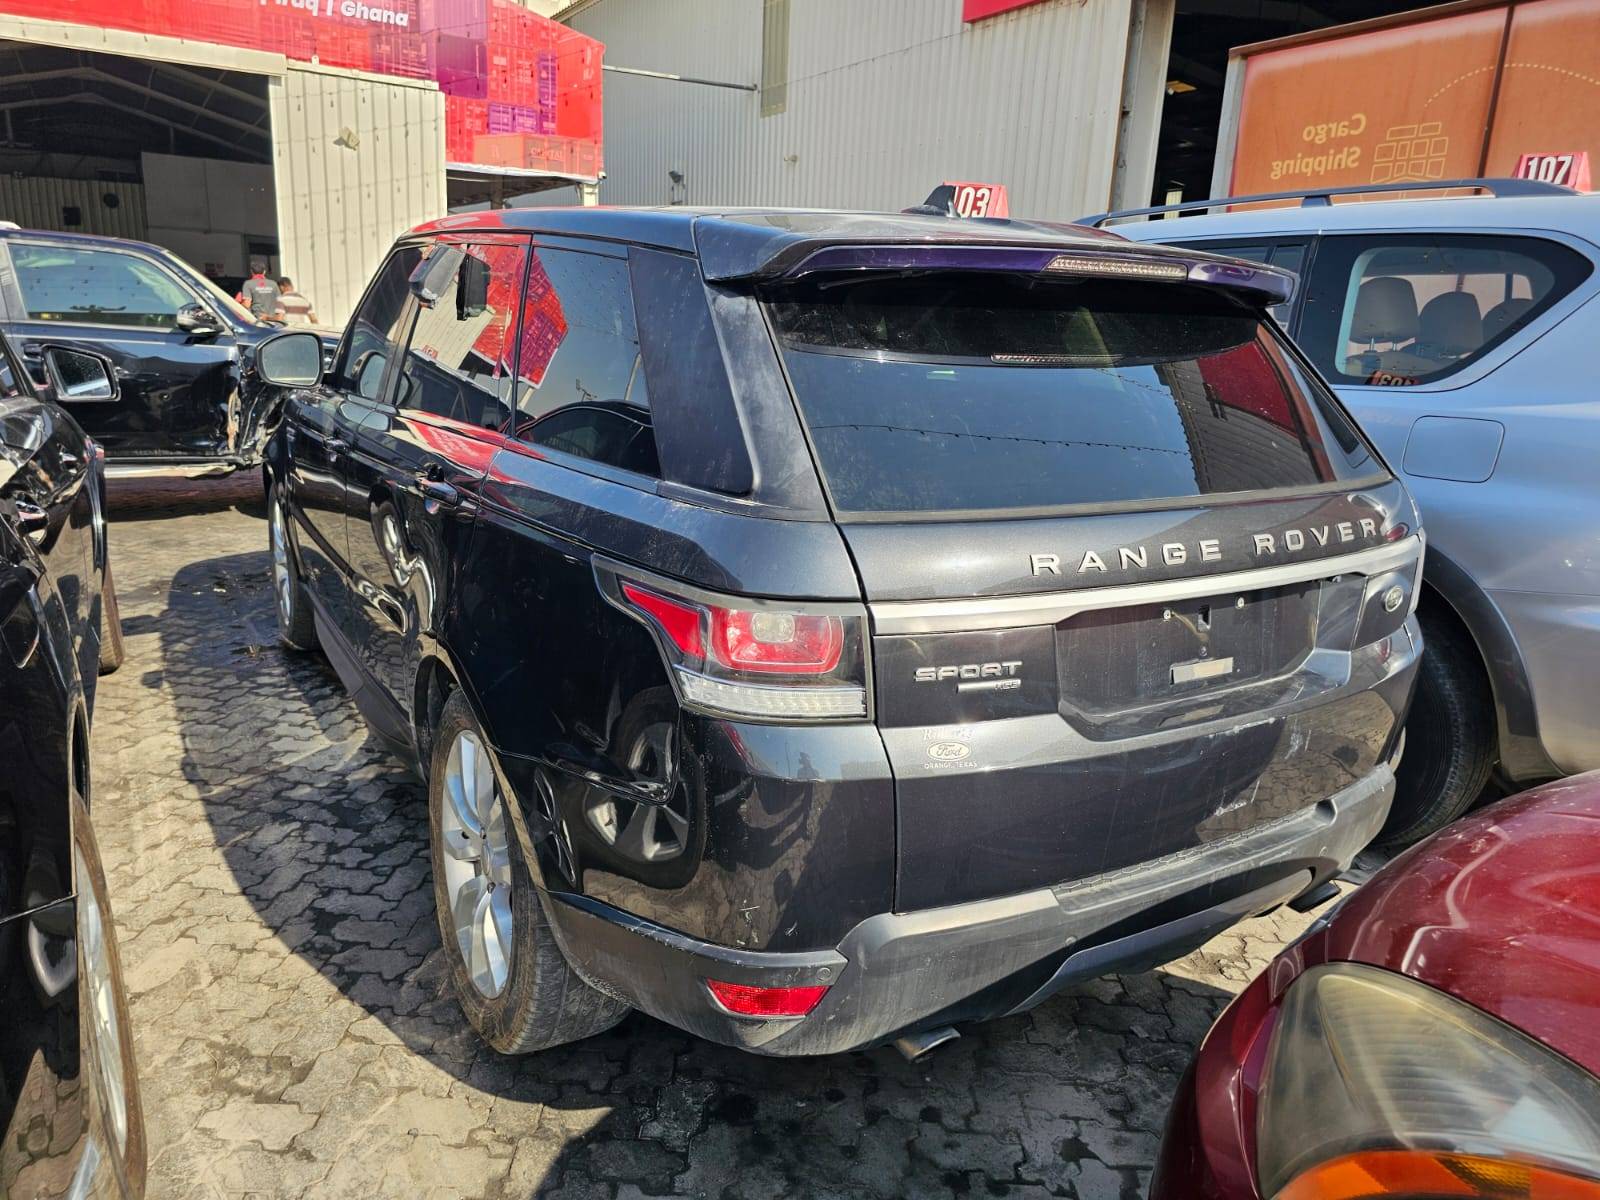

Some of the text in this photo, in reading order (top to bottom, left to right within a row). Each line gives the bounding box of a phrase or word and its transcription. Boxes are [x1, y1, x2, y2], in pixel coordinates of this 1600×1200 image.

[275, 0, 409, 26] aq Ghana
[1527, 155, 1573, 185] 107
[1030, 517, 1377, 577] RANGE ROVER
[913, 660, 1022, 682] SPORT
[936, 743, 963, 757] Ford
